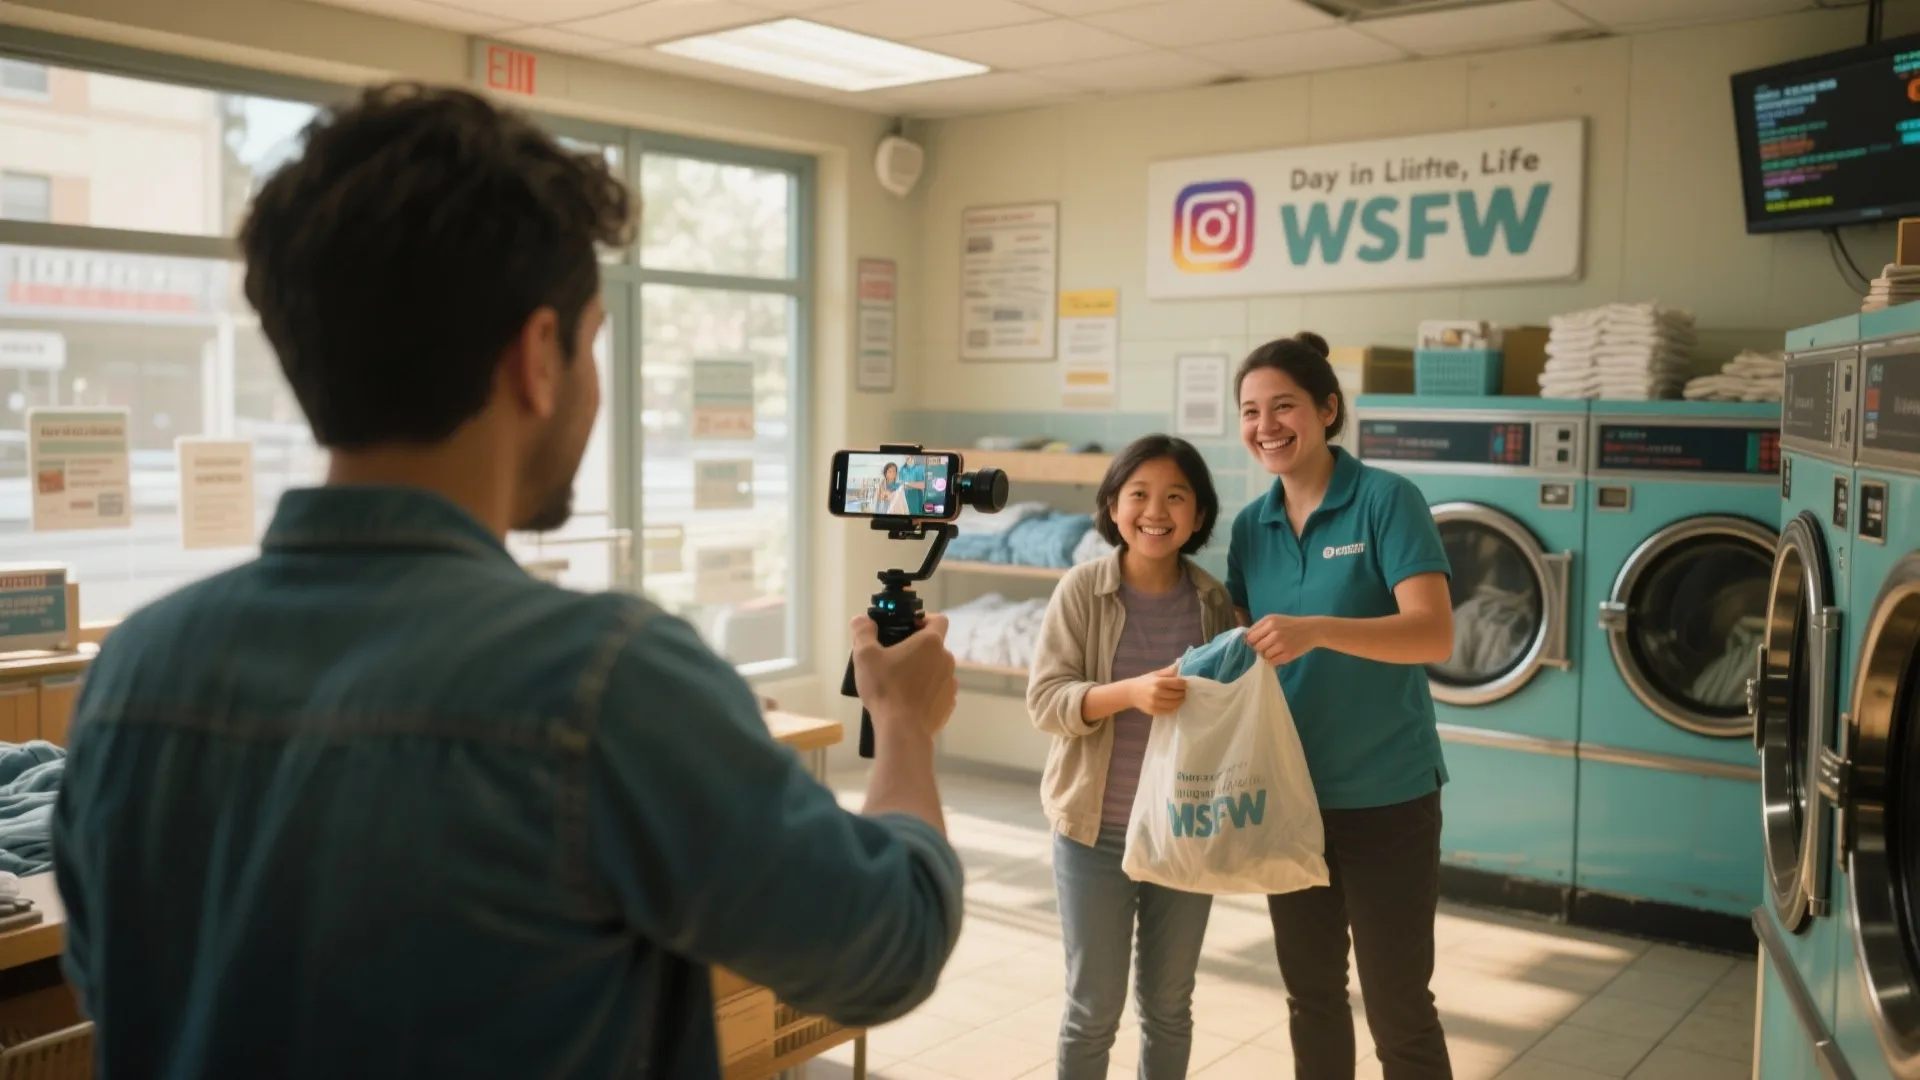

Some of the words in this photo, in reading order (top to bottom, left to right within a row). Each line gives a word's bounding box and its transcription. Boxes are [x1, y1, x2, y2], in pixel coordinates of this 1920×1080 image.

[1291, 167, 1339, 194] Day
[1349, 161, 1374, 185] in
[1481, 146, 1541, 175] Life
[1280, 181, 1553, 267] WSFW
[1167, 789, 1267, 837] WSFW
